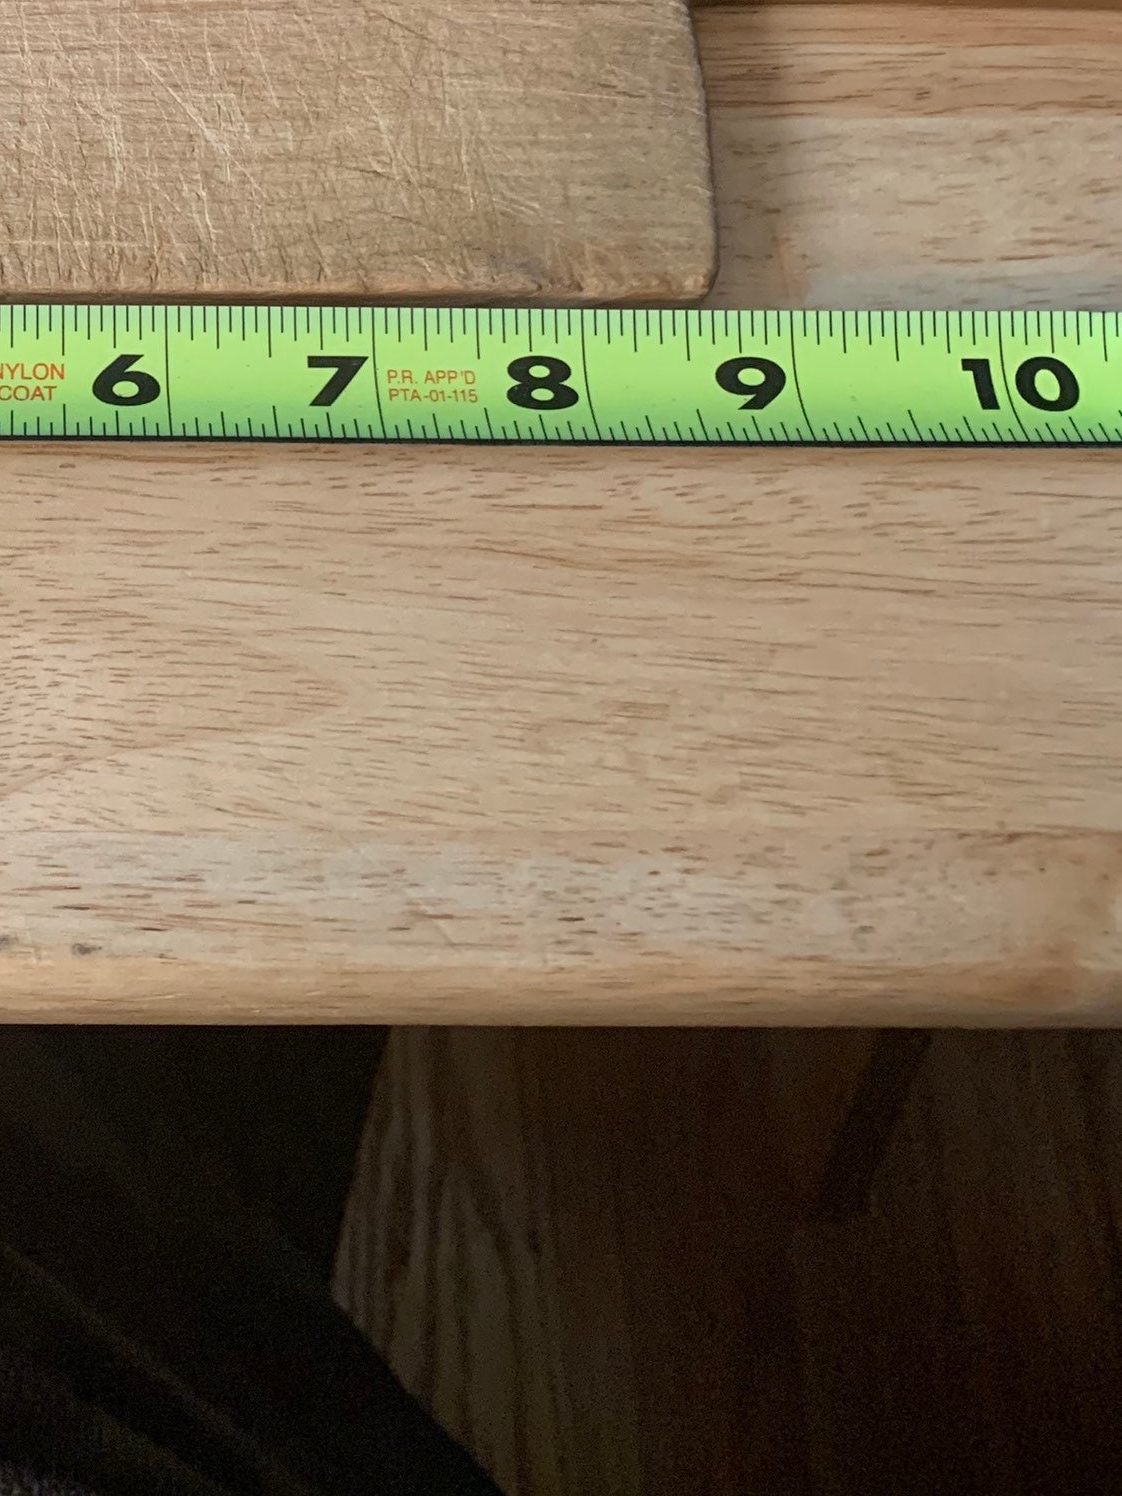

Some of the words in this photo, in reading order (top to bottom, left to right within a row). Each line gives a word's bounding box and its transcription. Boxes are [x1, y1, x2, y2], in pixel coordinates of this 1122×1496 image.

[91, 353, 161, 406] 6
[307, 355, 369, 407] 7
[387, 369, 419, 385] P.R.
[424, 369, 476, 386] APP'D
[388, 388, 479, 404] PTA-01-115
[506, 355, 579, 410] 8
[714, 356, 787, 411] 9
[960, 355, 1081, 412] 10
